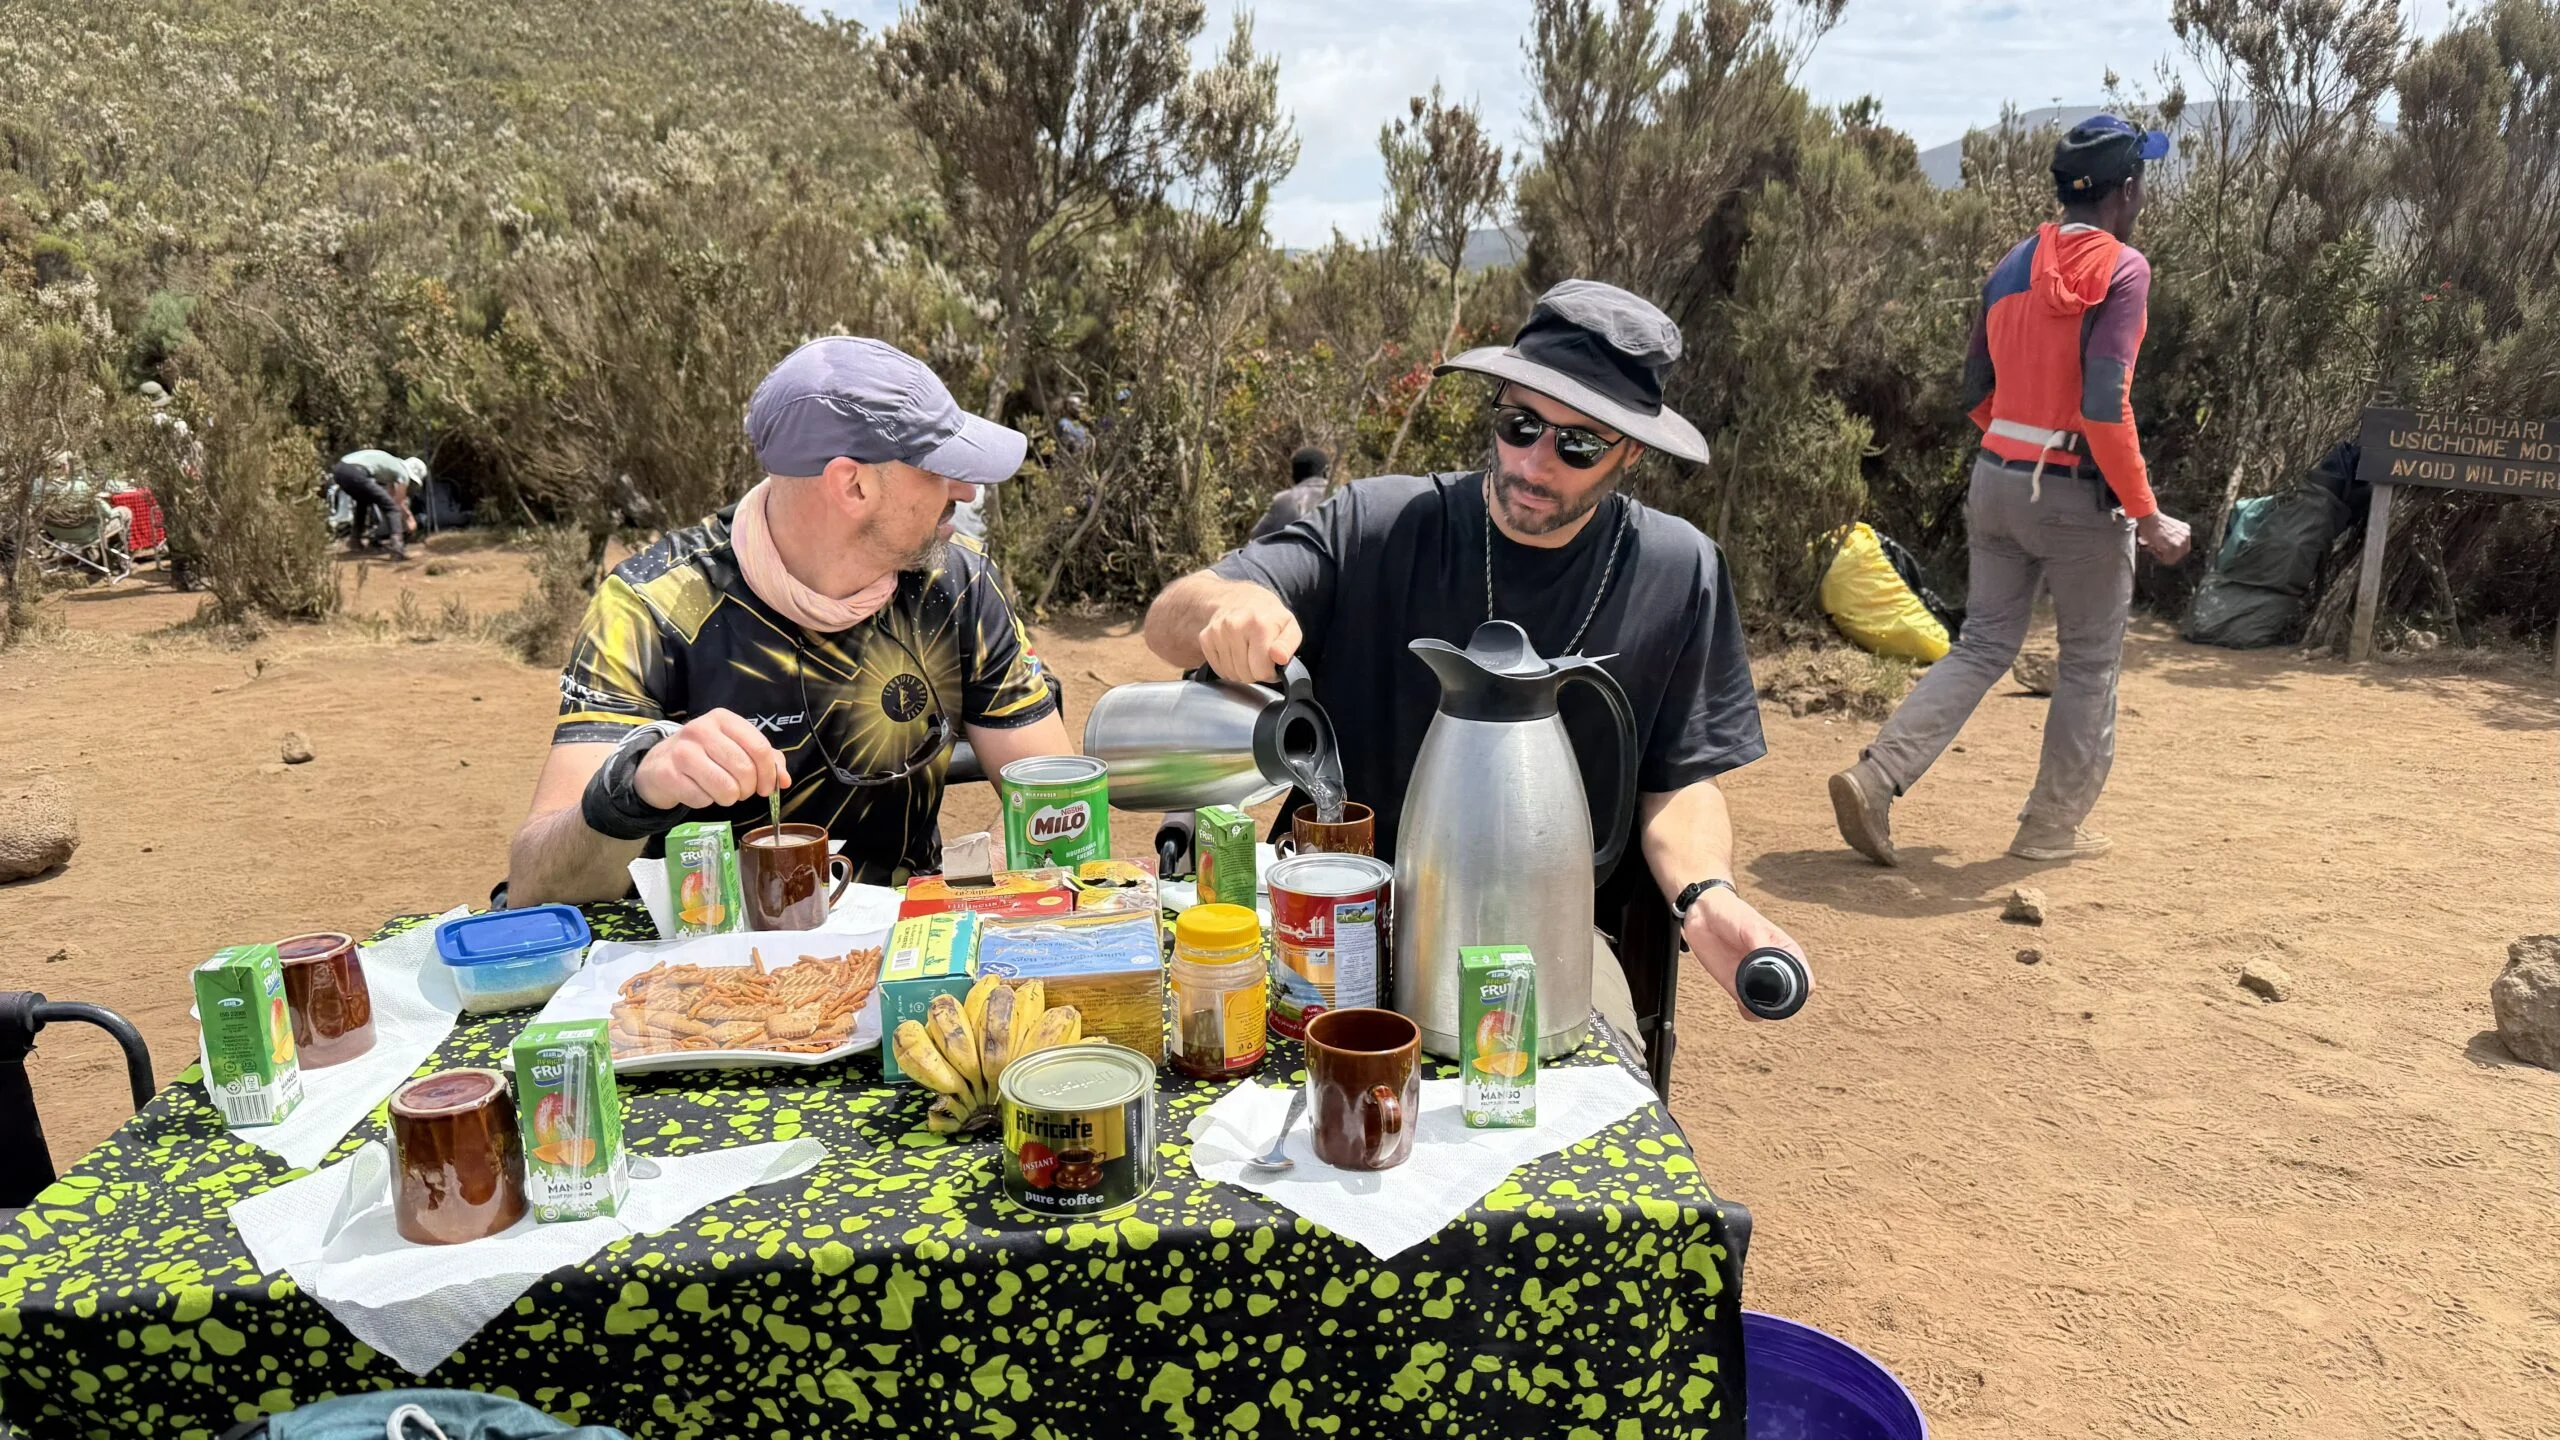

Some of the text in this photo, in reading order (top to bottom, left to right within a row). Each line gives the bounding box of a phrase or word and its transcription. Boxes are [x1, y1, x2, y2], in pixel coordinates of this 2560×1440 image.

[2415, 412, 2545, 441] TAHADHARI
[2389, 429, 2509, 458] USICHOME
[2390, 458, 2456, 481] AVOID
[1034, 812, 1086, 836] MILO
[1076, 847, 1096, 861] ENERGY
[1022, 1156, 1055, 1171] INSTANT
[1025, 1190, 1105, 1207] pure coffee
